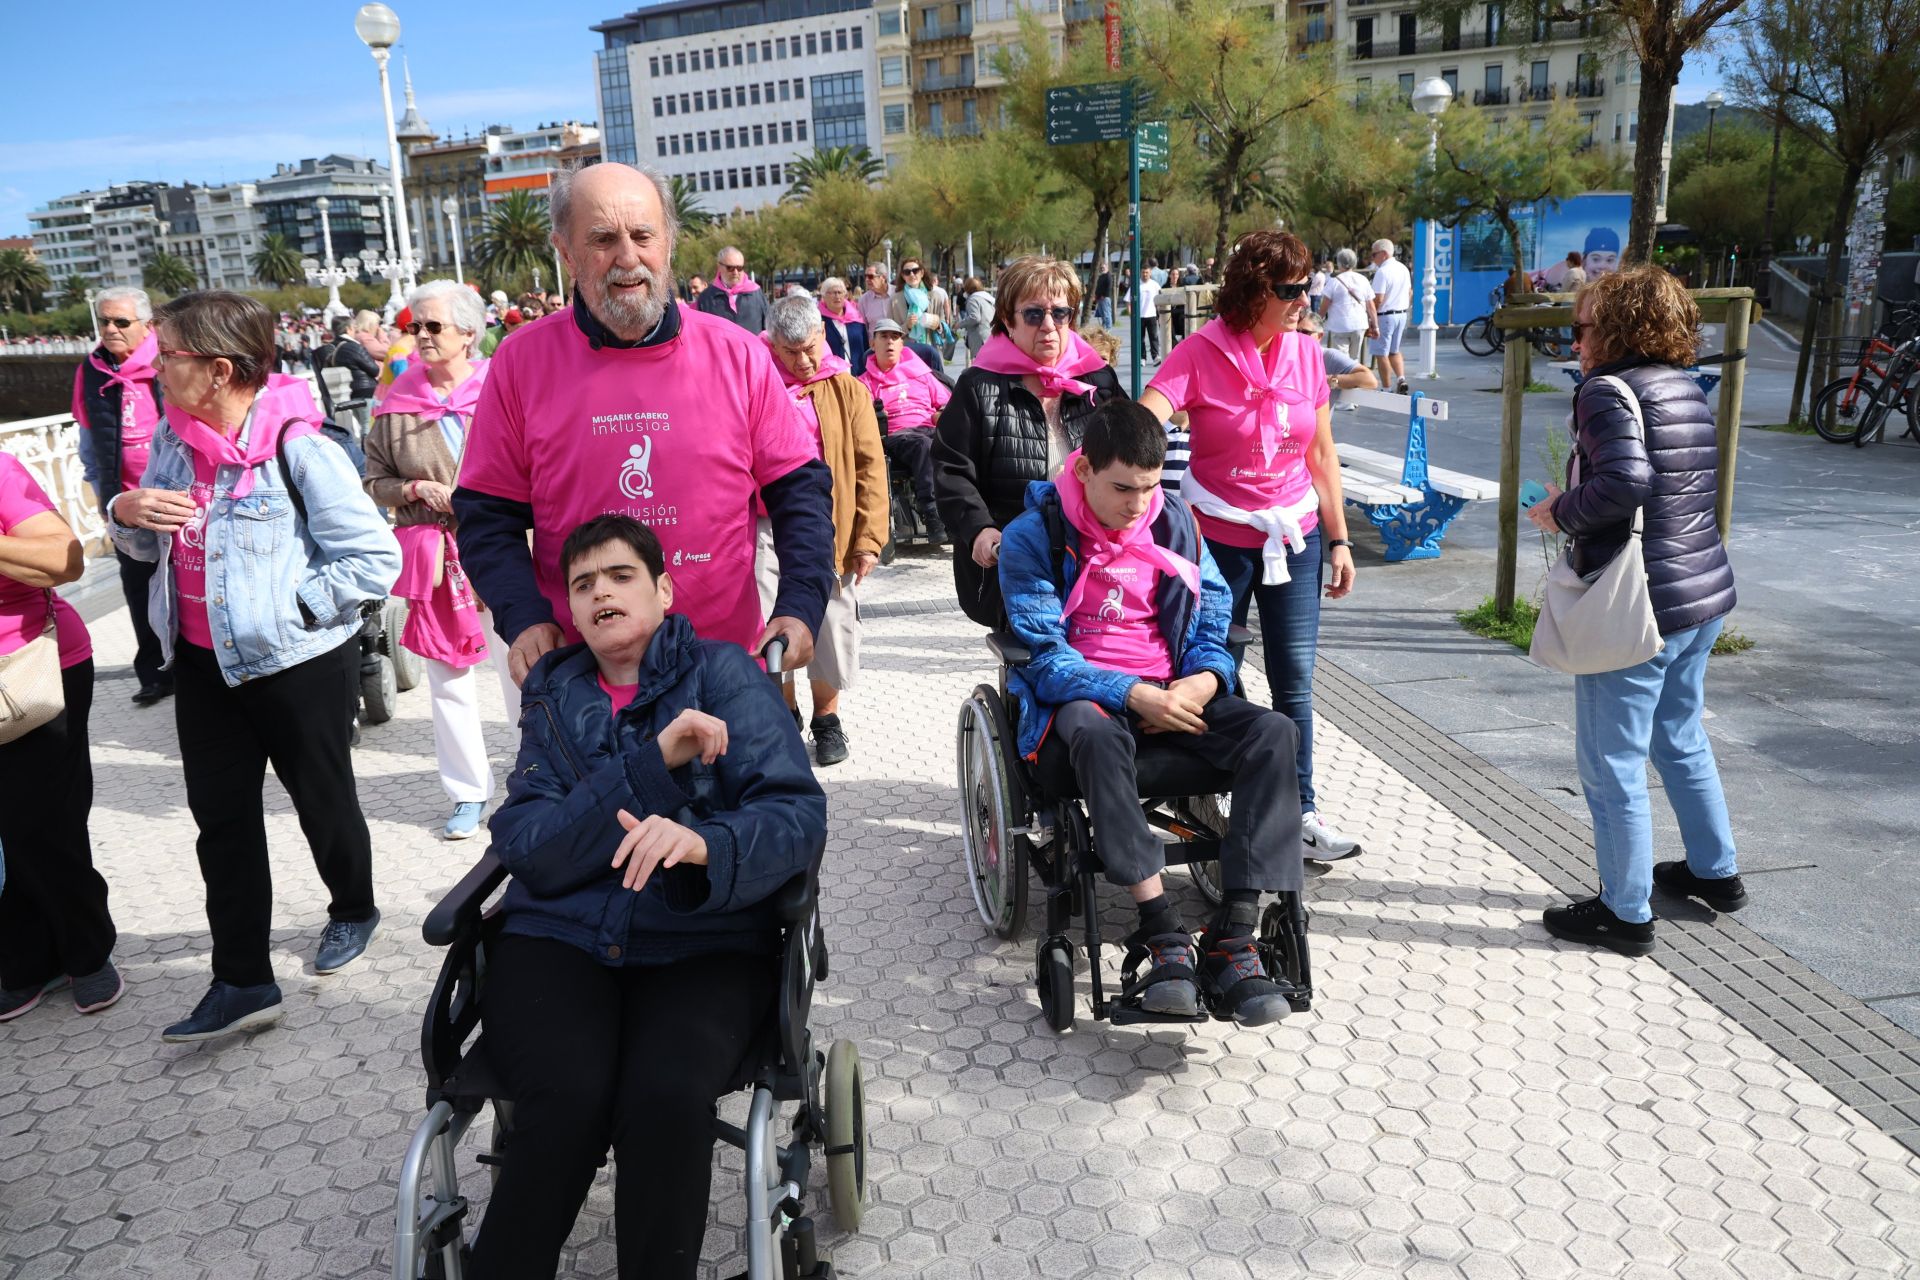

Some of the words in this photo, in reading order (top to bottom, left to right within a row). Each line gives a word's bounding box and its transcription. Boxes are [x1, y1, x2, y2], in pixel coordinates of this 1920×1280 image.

[592, 413, 633, 424] MUGARIK
[634, 412, 669, 420] GABEKO
[592, 419, 670, 435] inklusioa
[603, 504, 677, 517] inclusión
[637, 517, 678, 526] MITES
